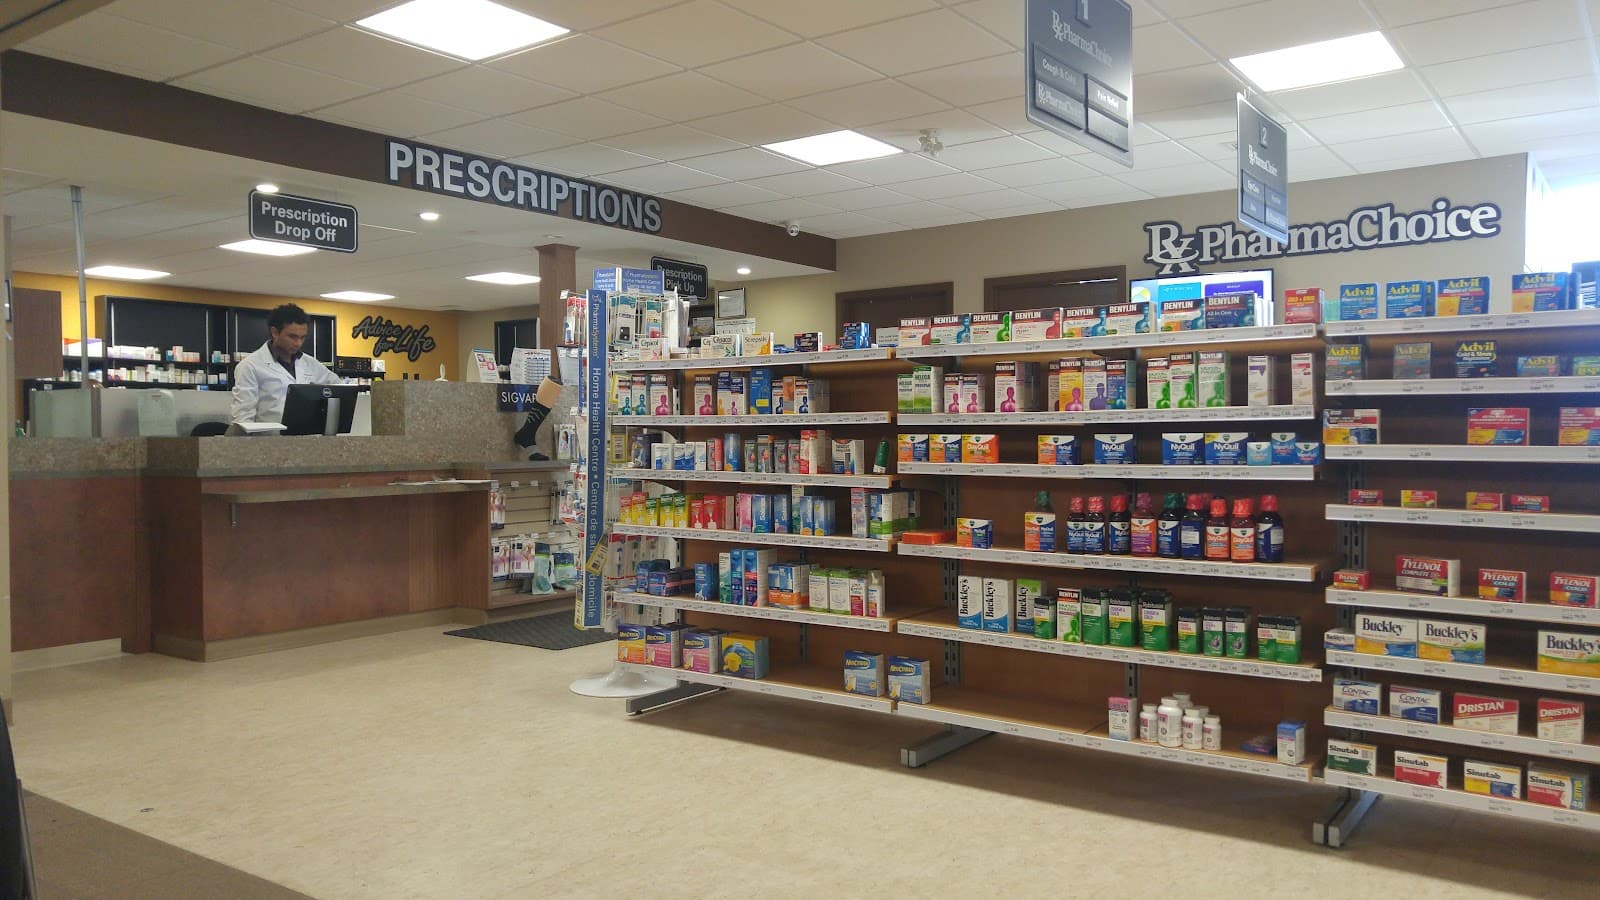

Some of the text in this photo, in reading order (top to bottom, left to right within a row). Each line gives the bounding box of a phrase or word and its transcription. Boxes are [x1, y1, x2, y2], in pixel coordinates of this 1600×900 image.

[1262, 127, 1268, 145] 2
[389, 141, 662, 232] PRESCRIPTIONS
[261, 201, 348, 228] Prescription
[275, 220, 337, 242] Drop Off
[1198, 201, 1498, 262] PharmaChoice
[1447, 278, 1480, 289] Advil
[1520, 273, 1555, 284] Advil
[666, 278, 695, 293] Pick Up
[1391, 283, 1420, 295] Advil
[1344, 286, 1375, 297] Advil
[1163, 301, 1194, 310] BENYLIN
[1208, 296, 1240, 306] BENYLIN
[1066, 308, 1094, 317] BENYLIN
[1109, 304, 1137, 314] BENYLIN
[933, 315, 959, 324] BENYLIN
[972, 314, 999, 323] BENYLIN
[1015, 311, 1042, 320] BENYLIN
[353, 317, 400, 337] Advice
[900, 319, 926, 327] BENYLIN
[592, 303, 600, 355] PharmaSystems
[394, 325, 435, 361] Life
[1459, 341, 1495, 352] Advil
[1329, 346, 1360, 356] Advil
[1397, 345, 1428, 355] Advil
[1527, 356, 1556, 365] Advil
[592, 367, 601, 399] Home
[592, 401, 601, 436] Health
[1101, 443, 1125, 452] NyQuil
[1170, 442, 1196, 452] NyQuil
[1213, 442, 1240, 451] NyQuil
[590, 437, 600, 475] Centre
[588, 482, 600, 516] Centre
[589, 518, 599, 531] de
[1402, 558, 1442, 572] TYLENOL
[1482, 571, 1518, 582] TYLENOL
[1554, 576, 1591, 587] TYLENOL
[586, 573, 599, 619] domicile
[985, 581, 996, 618] Buckley's
[1362, 617, 1403, 636] Buckley
[1425, 623, 1478, 643] Buckley's
[1341, 685, 1372, 696] CONTAC
[1399, 693, 1431, 704] CONTAC
[1458, 701, 1505, 714] DRISTAN
[1540, 706, 1580, 717] DRISTAN
[1329, 744, 1359, 755] Sinutab
[1396, 756, 1429, 767] Sinutab
[1466, 768, 1501, 780] Sinutab
[1529, 775, 1566, 788] Sinutab
